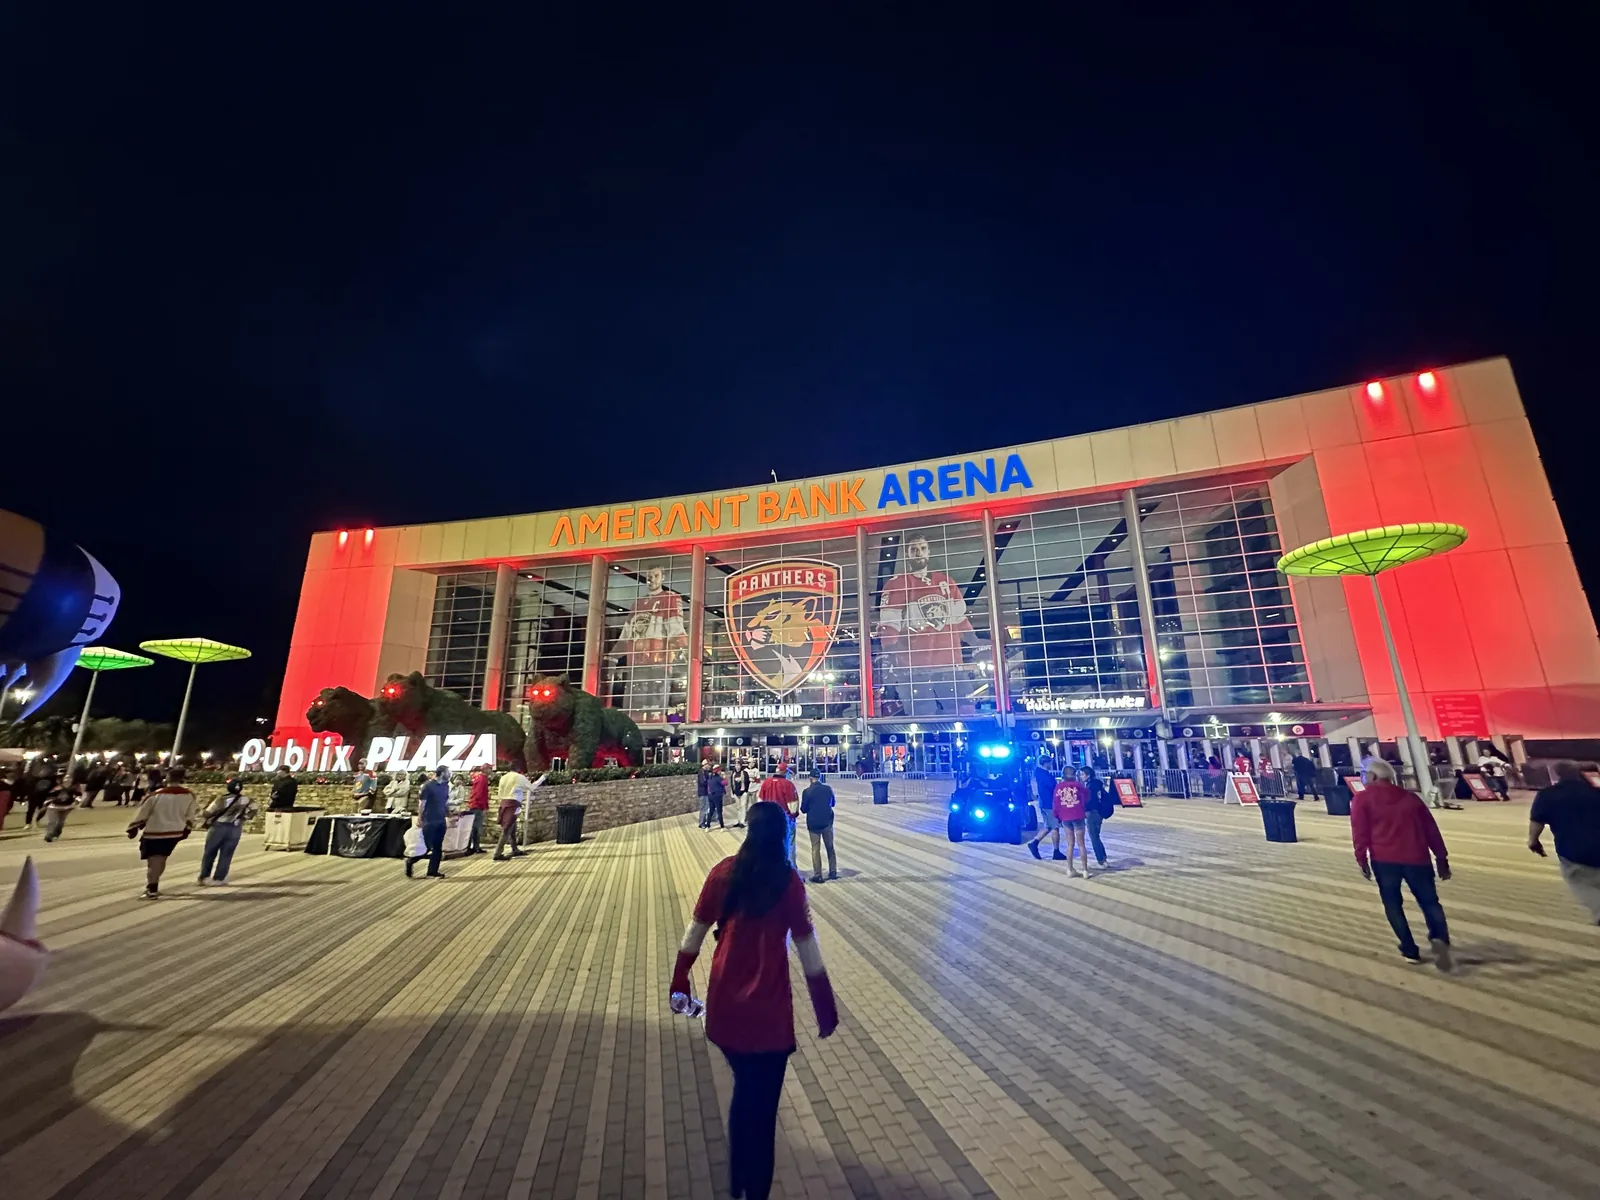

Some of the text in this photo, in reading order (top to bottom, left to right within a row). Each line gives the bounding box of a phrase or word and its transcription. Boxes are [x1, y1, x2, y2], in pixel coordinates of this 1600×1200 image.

[549, 453, 1034, 547] AMERANT BANK ARENA
[738, 569, 828, 596] PANTHERS
[720, 704, 803, 719] PANTHERLAND
[1070, 696, 1146, 710] ENTRANCE
[239, 733, 498, 772] Publix PLAZA
